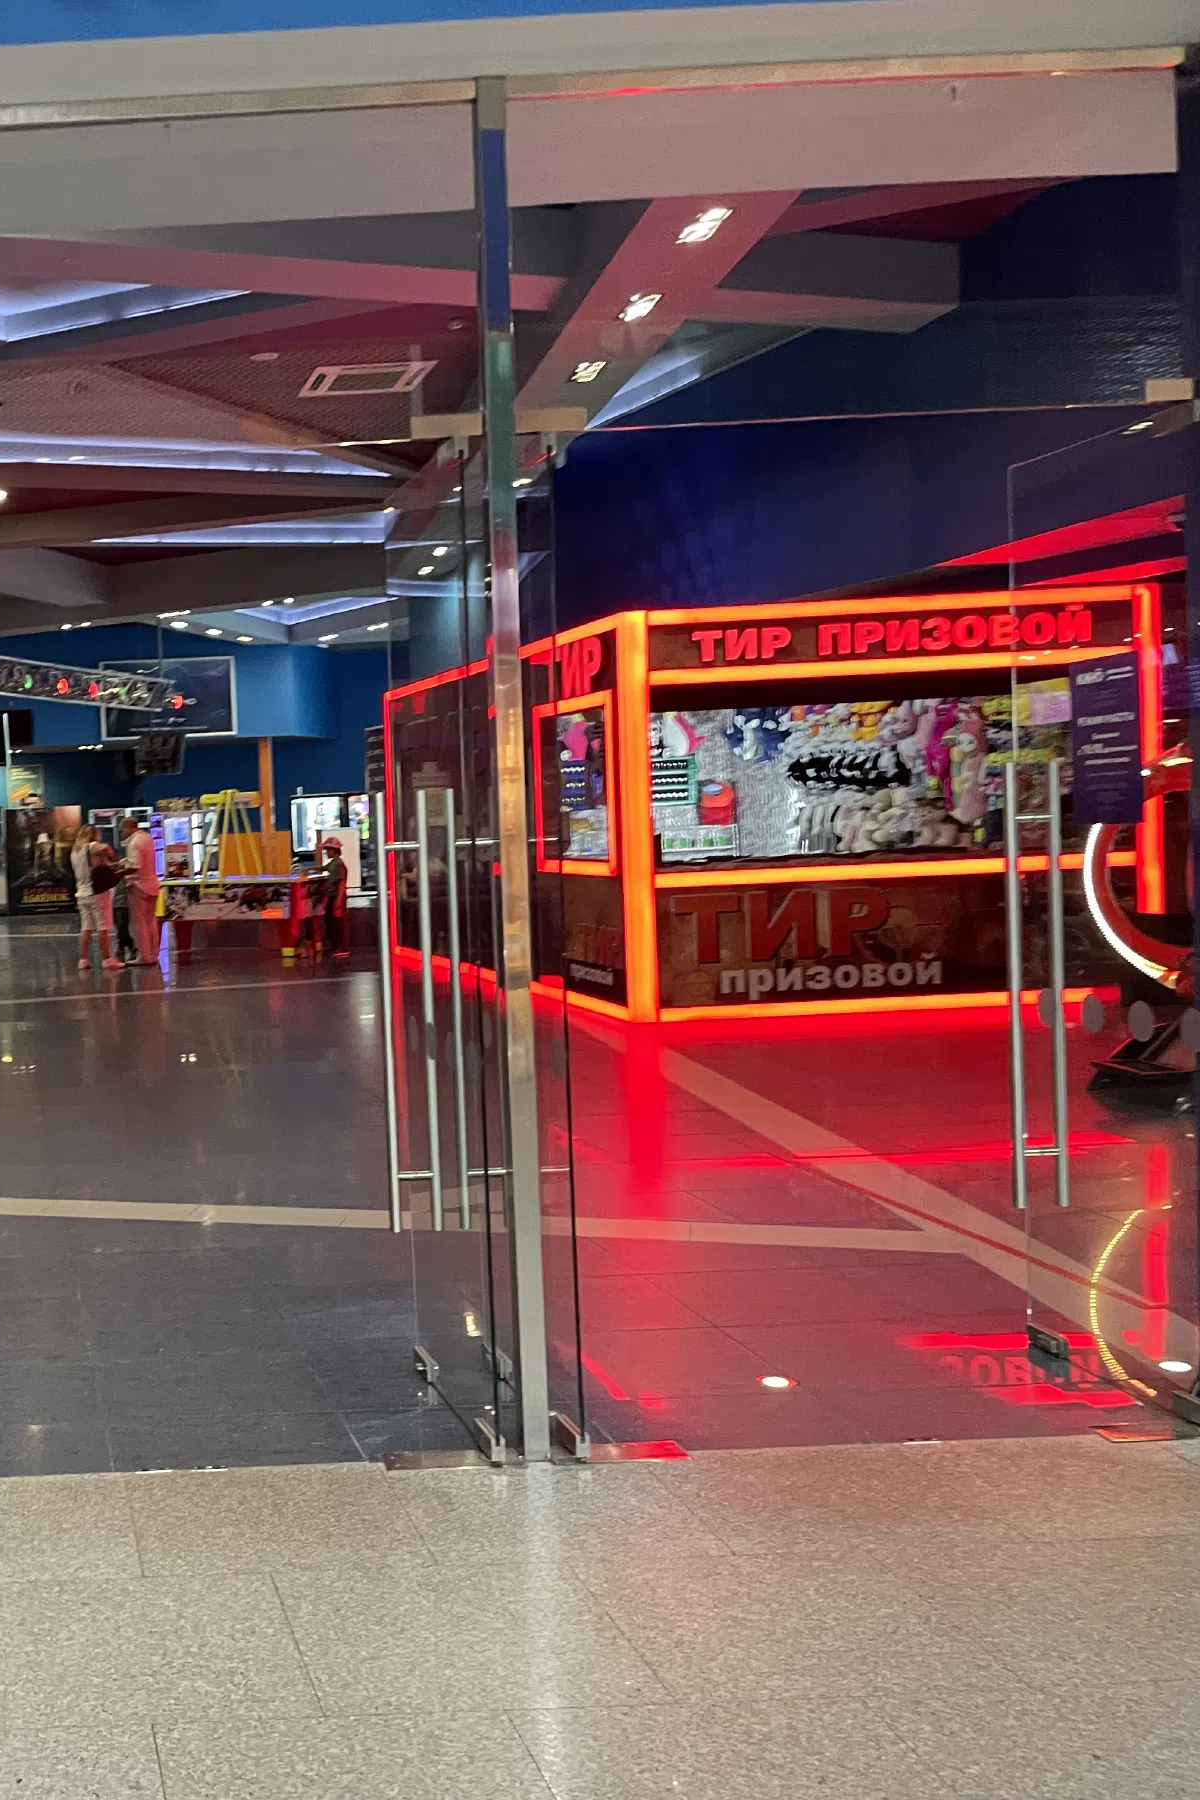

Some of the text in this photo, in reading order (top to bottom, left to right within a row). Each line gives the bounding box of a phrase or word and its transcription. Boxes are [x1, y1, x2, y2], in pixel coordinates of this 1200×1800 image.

[692, 604, 1093, 662] ТИР ПРИЗОВОЙ
[670, 886, 890, 964] ТИР
[720, 952, 943, 1000] призовой
